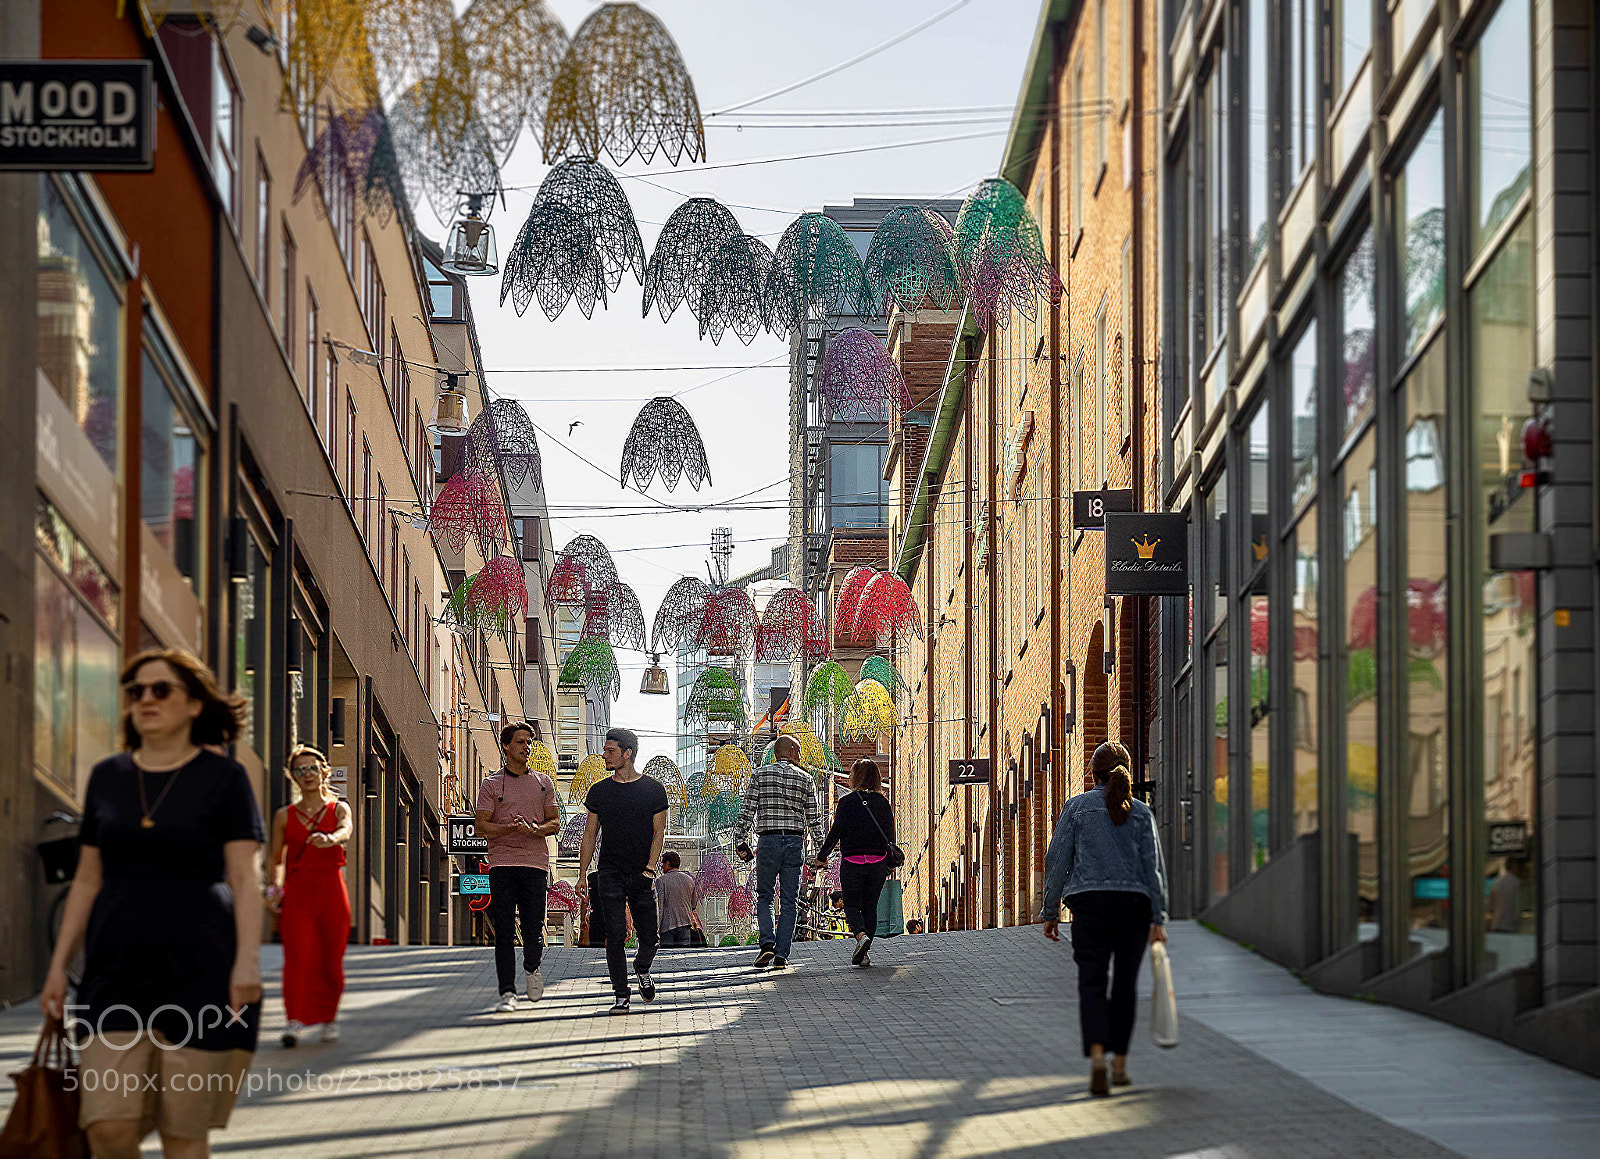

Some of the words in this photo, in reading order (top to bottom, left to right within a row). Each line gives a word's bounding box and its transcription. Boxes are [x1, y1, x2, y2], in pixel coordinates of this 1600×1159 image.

[0, 81, 136, 125] MOOD
[0, 126, 136, 148] STOCKHOLM
[1088, 498, 1104, 518] 18
[1111, 560, 1142, 572] Elodie
[958, 764, 976, 778] 22
[452, 824, 475, 840] MO
[452, 839, 488, 847] STOCKHO
